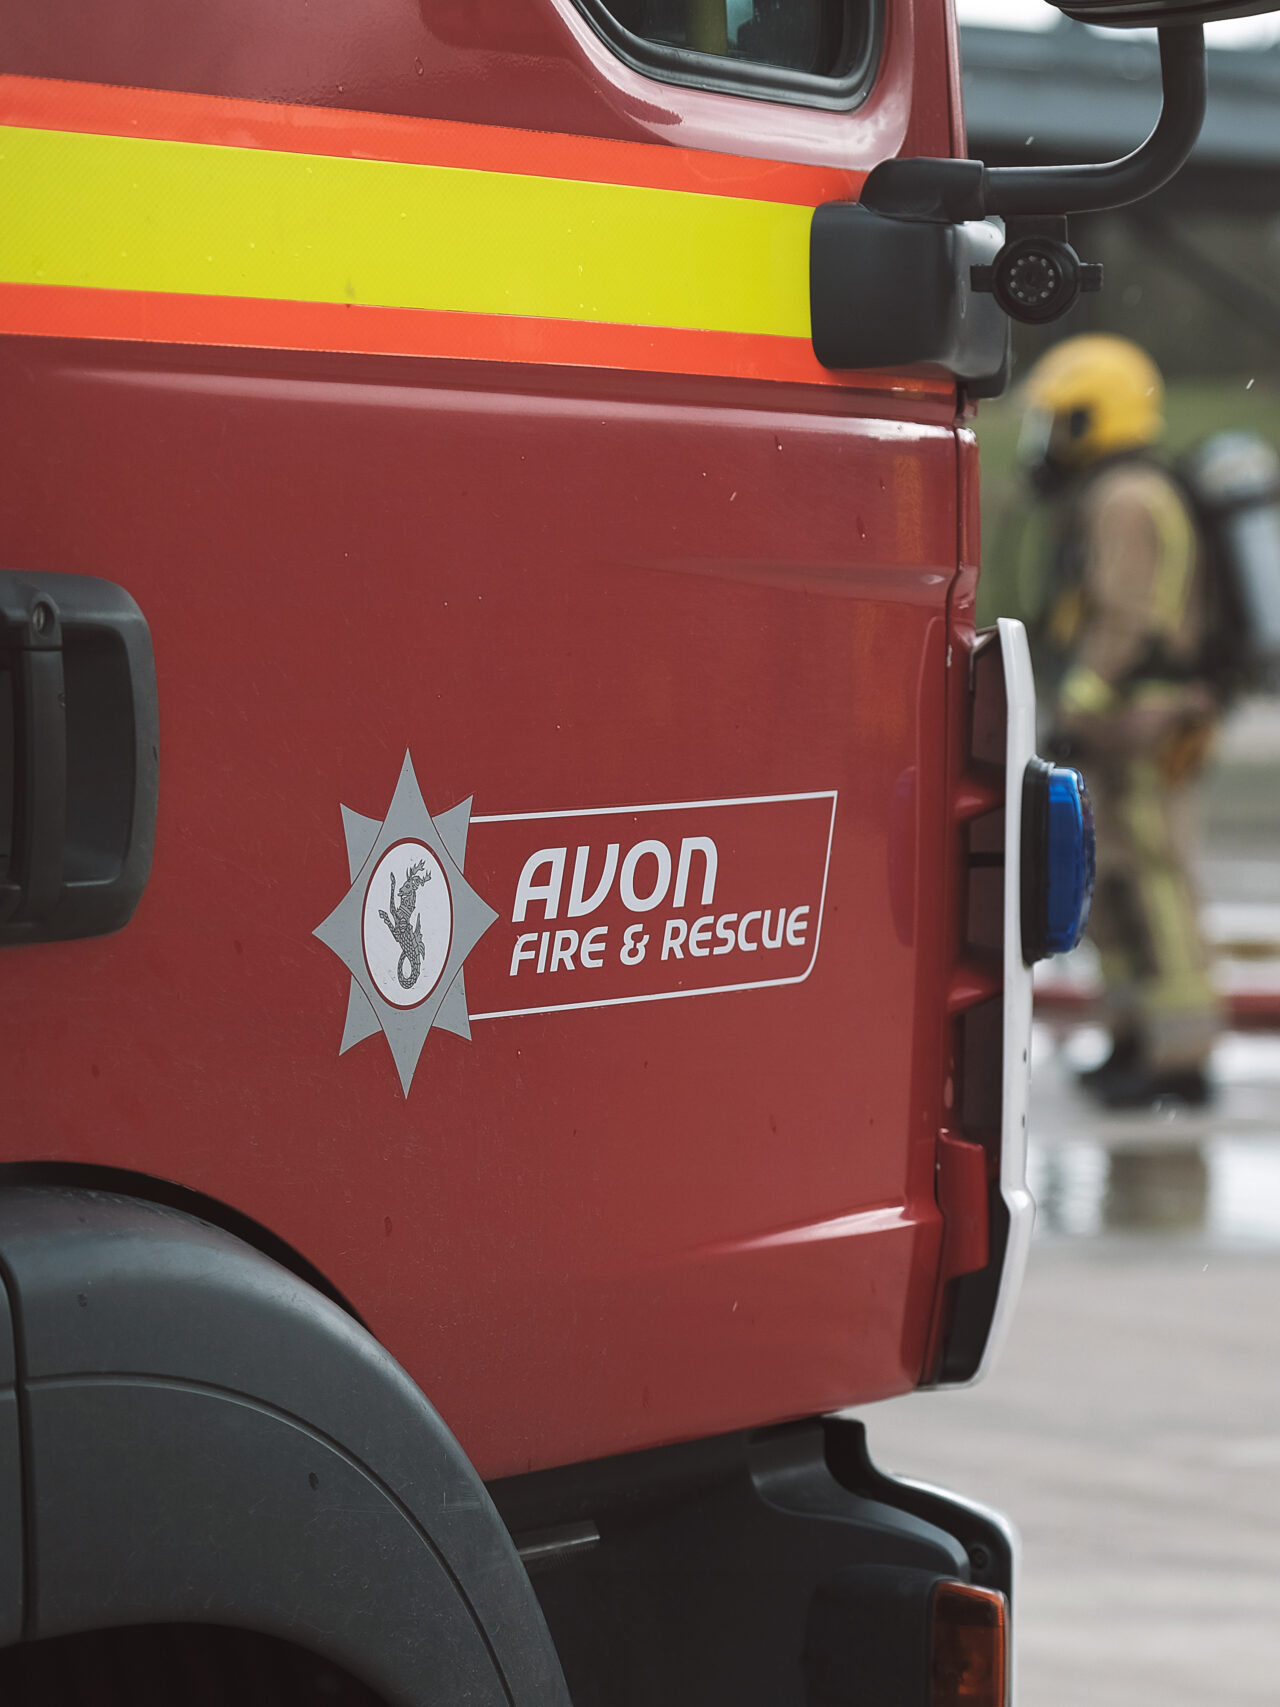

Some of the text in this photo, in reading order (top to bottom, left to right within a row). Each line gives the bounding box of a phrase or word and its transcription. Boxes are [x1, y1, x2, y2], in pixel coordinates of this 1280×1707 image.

[511, 836, 718, 923] AVON
[509, 905, 810, 977] FIRE & RESCUE
